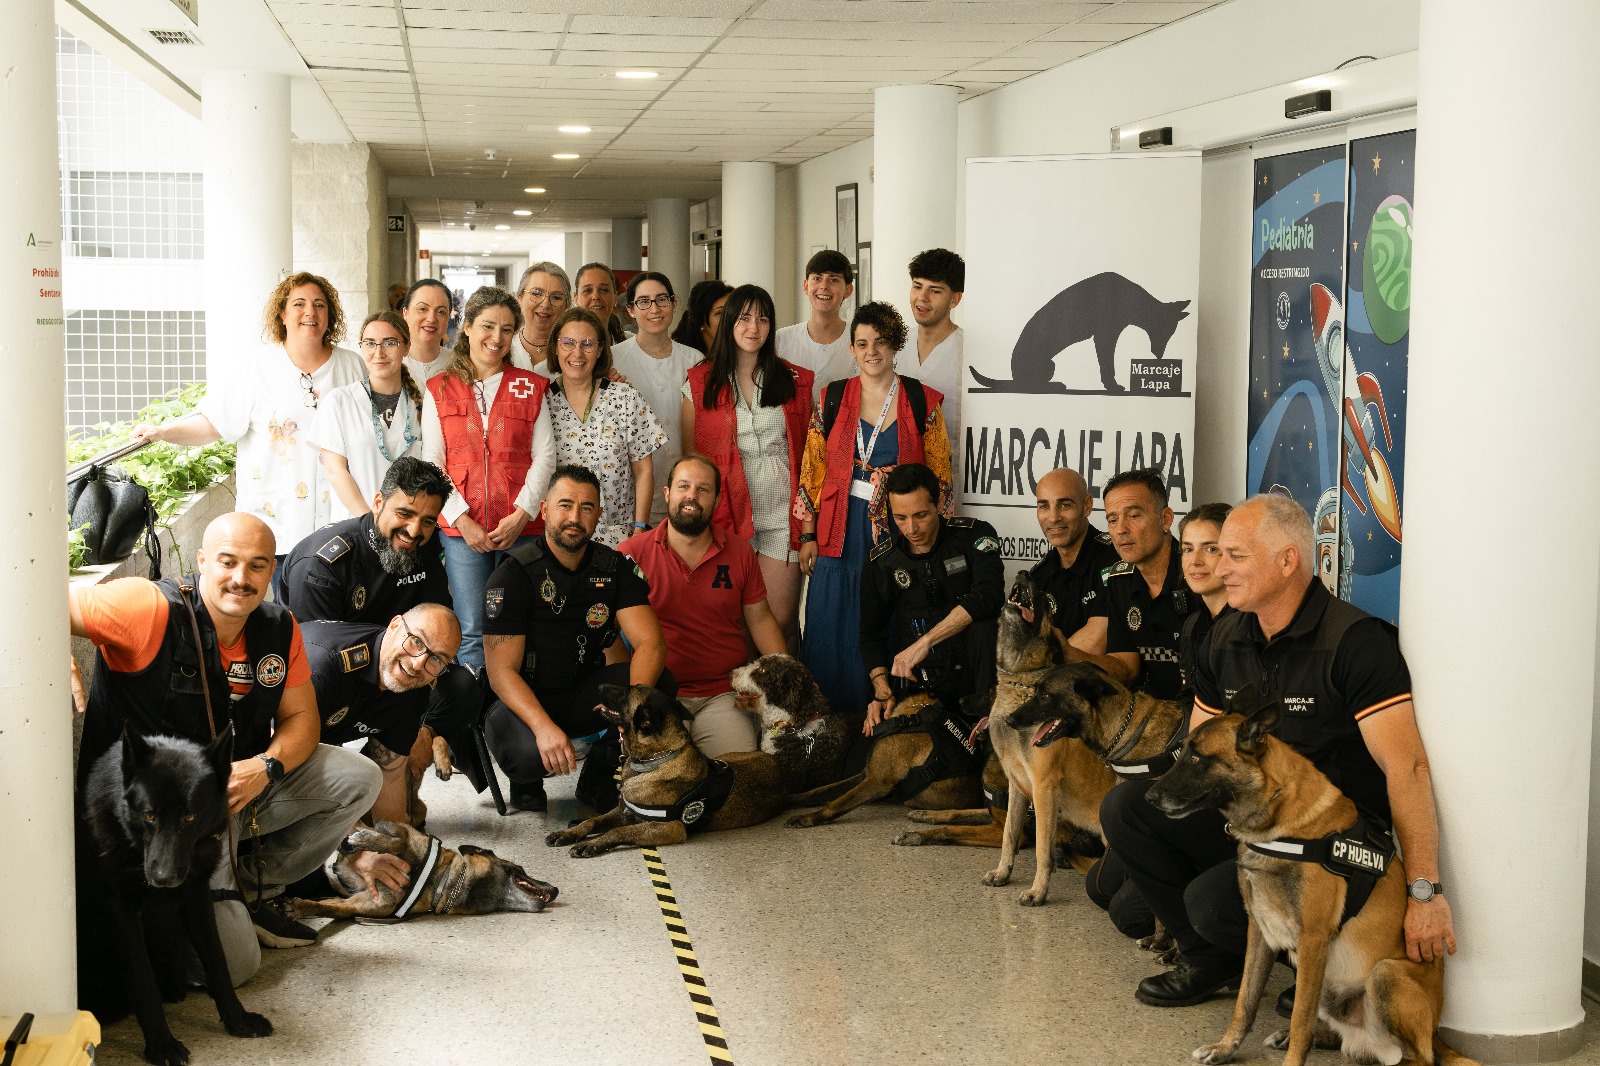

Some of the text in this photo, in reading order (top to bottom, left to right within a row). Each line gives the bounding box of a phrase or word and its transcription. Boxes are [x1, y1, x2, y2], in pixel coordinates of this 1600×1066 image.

[1260, 267, 1310, 279] ACCESO RESTRINGIDO
[1131, 363, 1181, 378] Marcaje
[1140, 378, 1171, 393] Lapa
[998, 536, 1016, 557] ROS
[711, 564, 733, 590] A
[1288, 704, 1308, 712] LAPA
[1332, 840, 1384, 872] CP HUELVA
